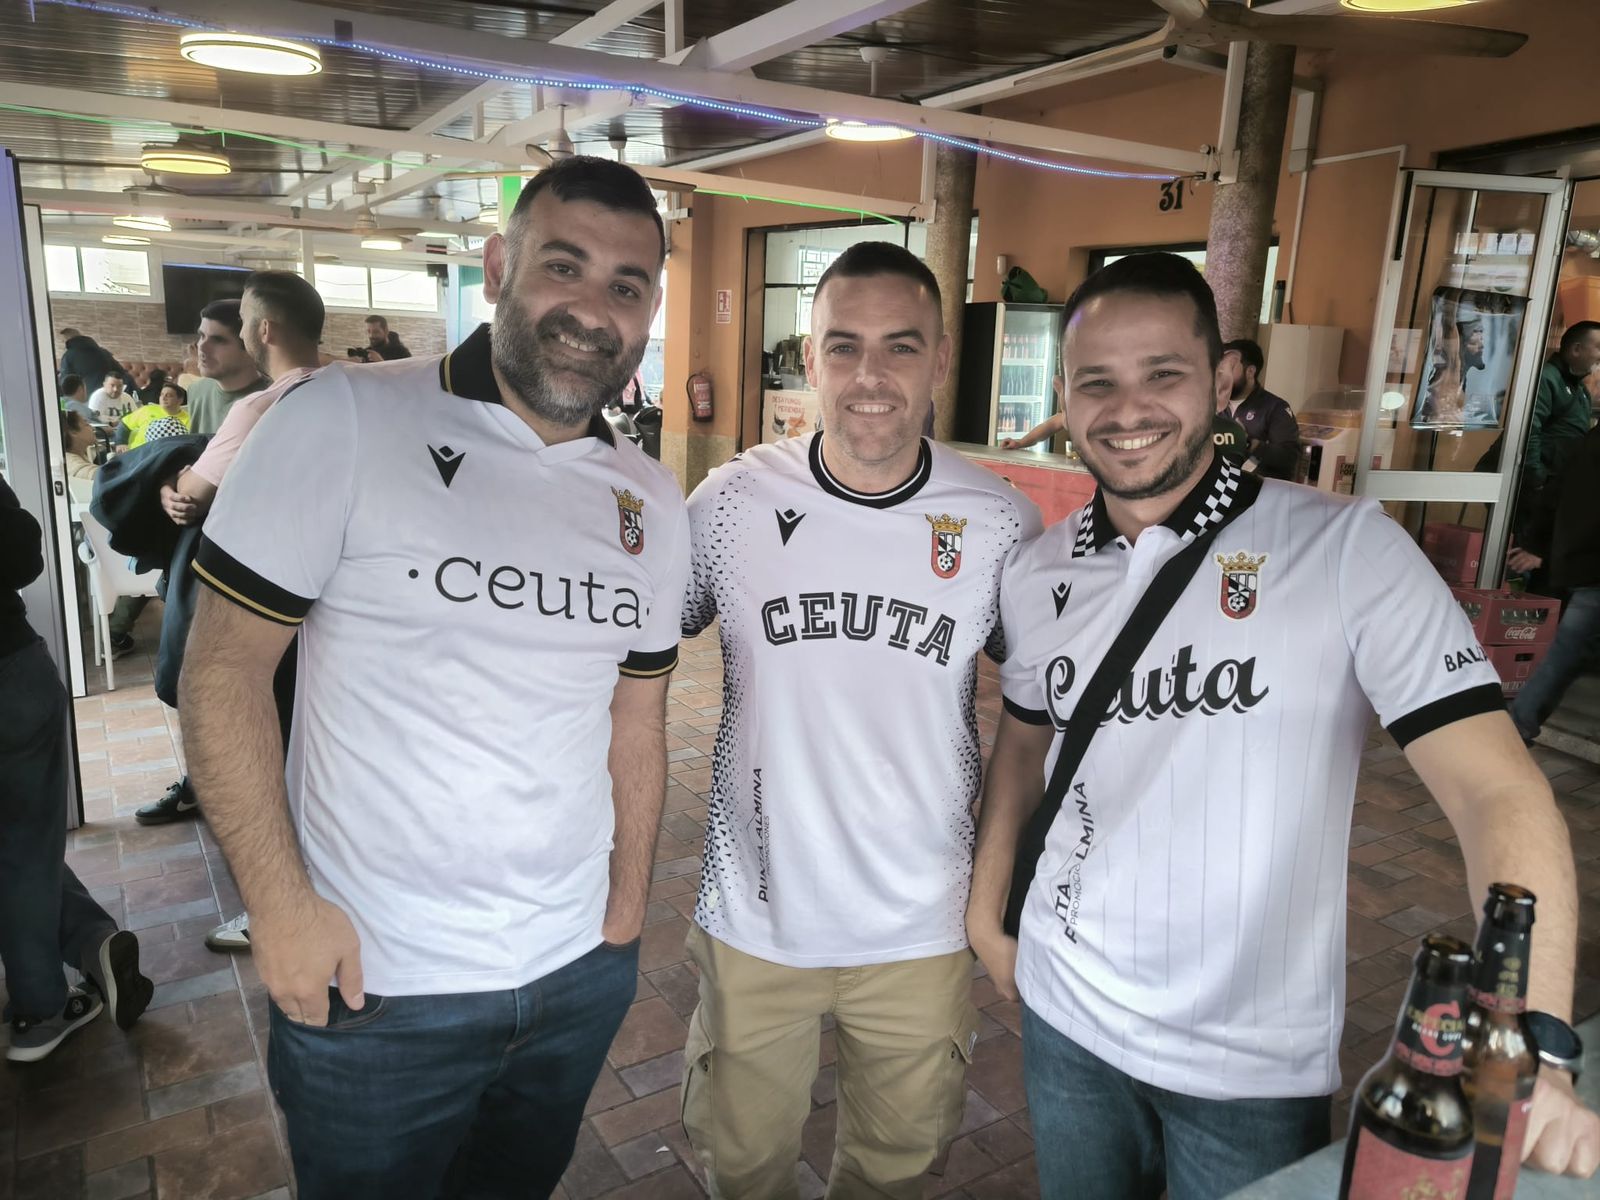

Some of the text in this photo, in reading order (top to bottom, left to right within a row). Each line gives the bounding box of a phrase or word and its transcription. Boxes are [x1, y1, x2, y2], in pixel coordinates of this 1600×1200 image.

[1159, 180, 1183, 211] 31
[761, 592, 956, 666] CEUTA
[1045, 644, 1270, 733] Cuta
[752, 768, 763, 840] ALMINA
[1073, 782, 1095, 861] LMINA
